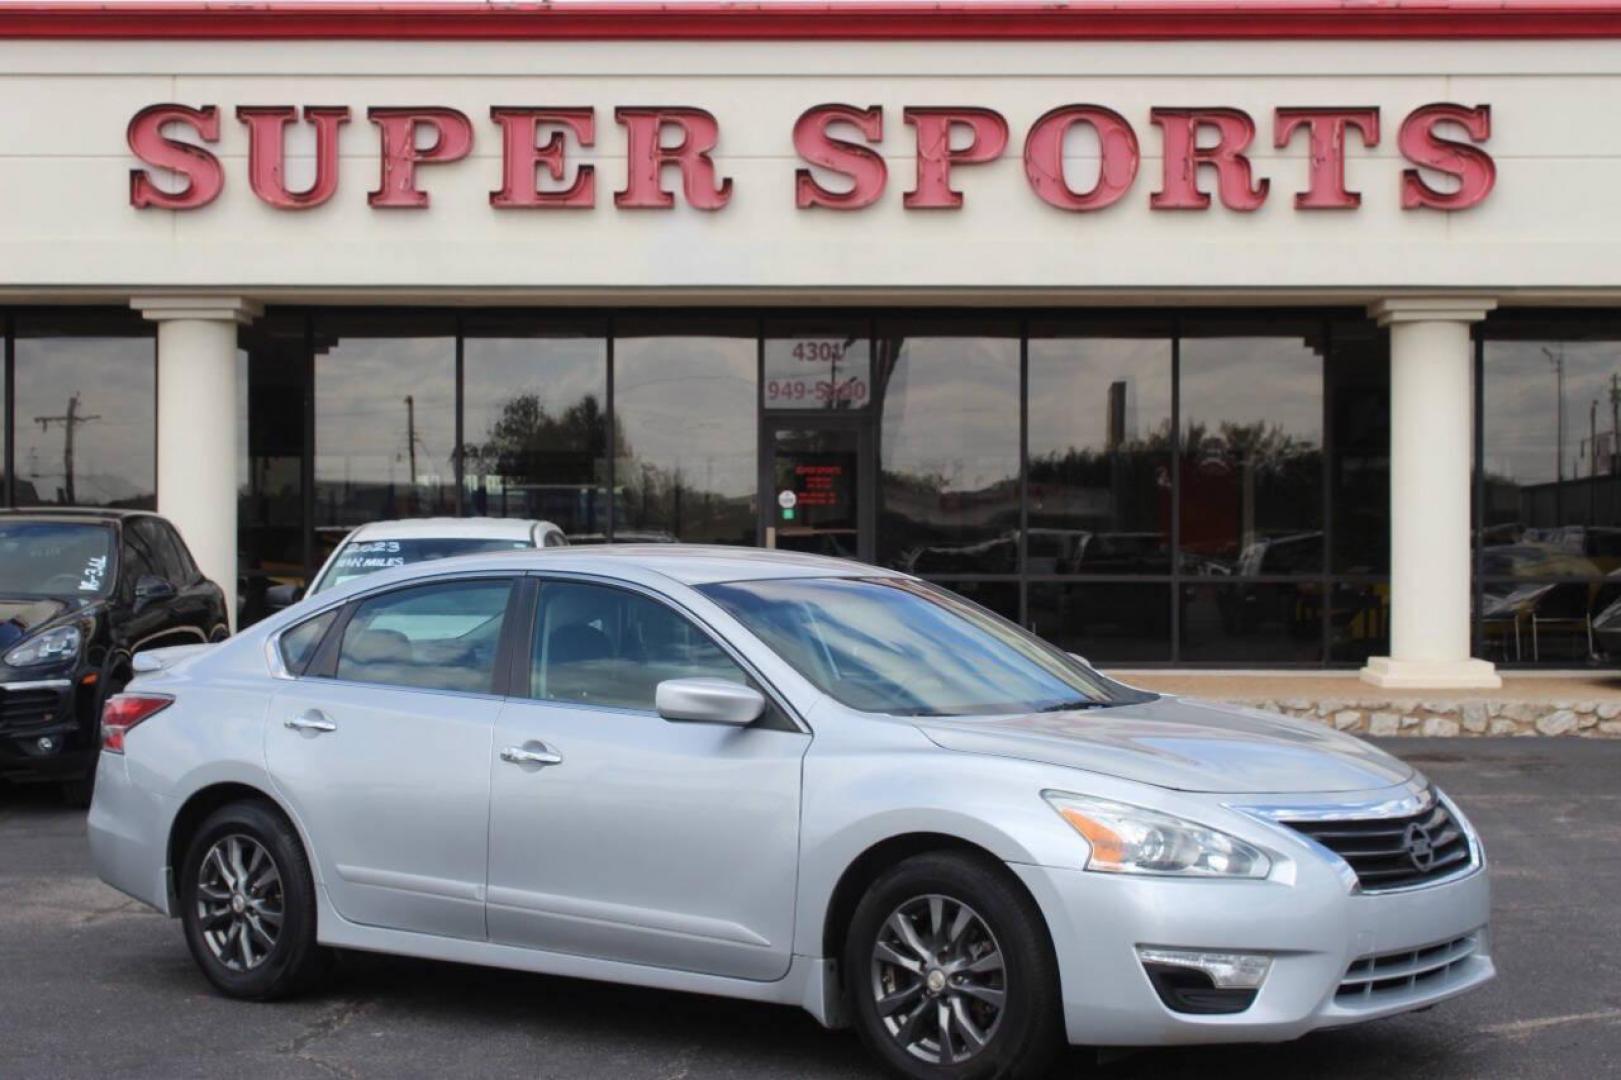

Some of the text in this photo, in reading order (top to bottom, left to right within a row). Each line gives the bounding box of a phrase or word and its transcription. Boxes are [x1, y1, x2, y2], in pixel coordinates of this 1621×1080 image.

[127, 102, 1497, 211] SUPER SPORTS
[792, 342, 846, 361] 4301
